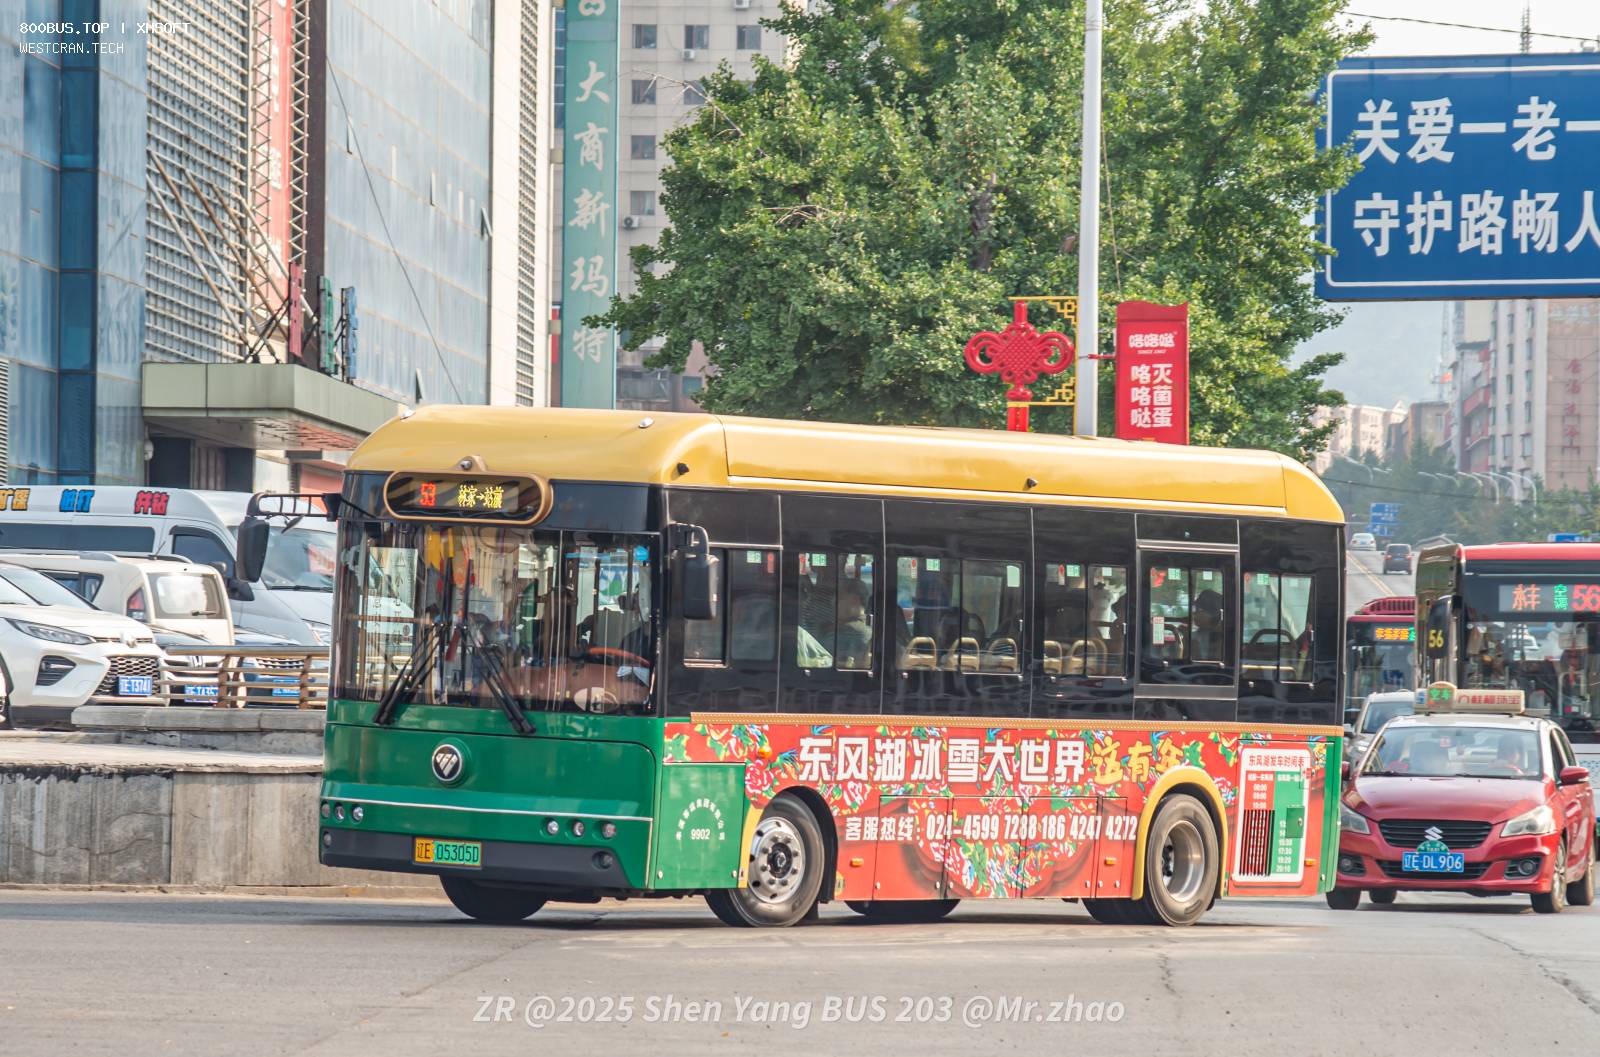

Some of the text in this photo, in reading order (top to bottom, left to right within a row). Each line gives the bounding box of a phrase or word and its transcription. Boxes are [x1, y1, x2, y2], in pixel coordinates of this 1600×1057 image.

[1355, 95, 1600, 164] 关爱一老一
[569, 60, 611, 364] 大商新玛特
[1353, 188, 1600, 257] 守护路畅人
[1572, 583, 1600, 612] 56
[1428, 629, 1444, 648] 56
[799, 736, 1085, 783] 东风湖冰雪大世界
[690, 829, 711, 840] 9902
